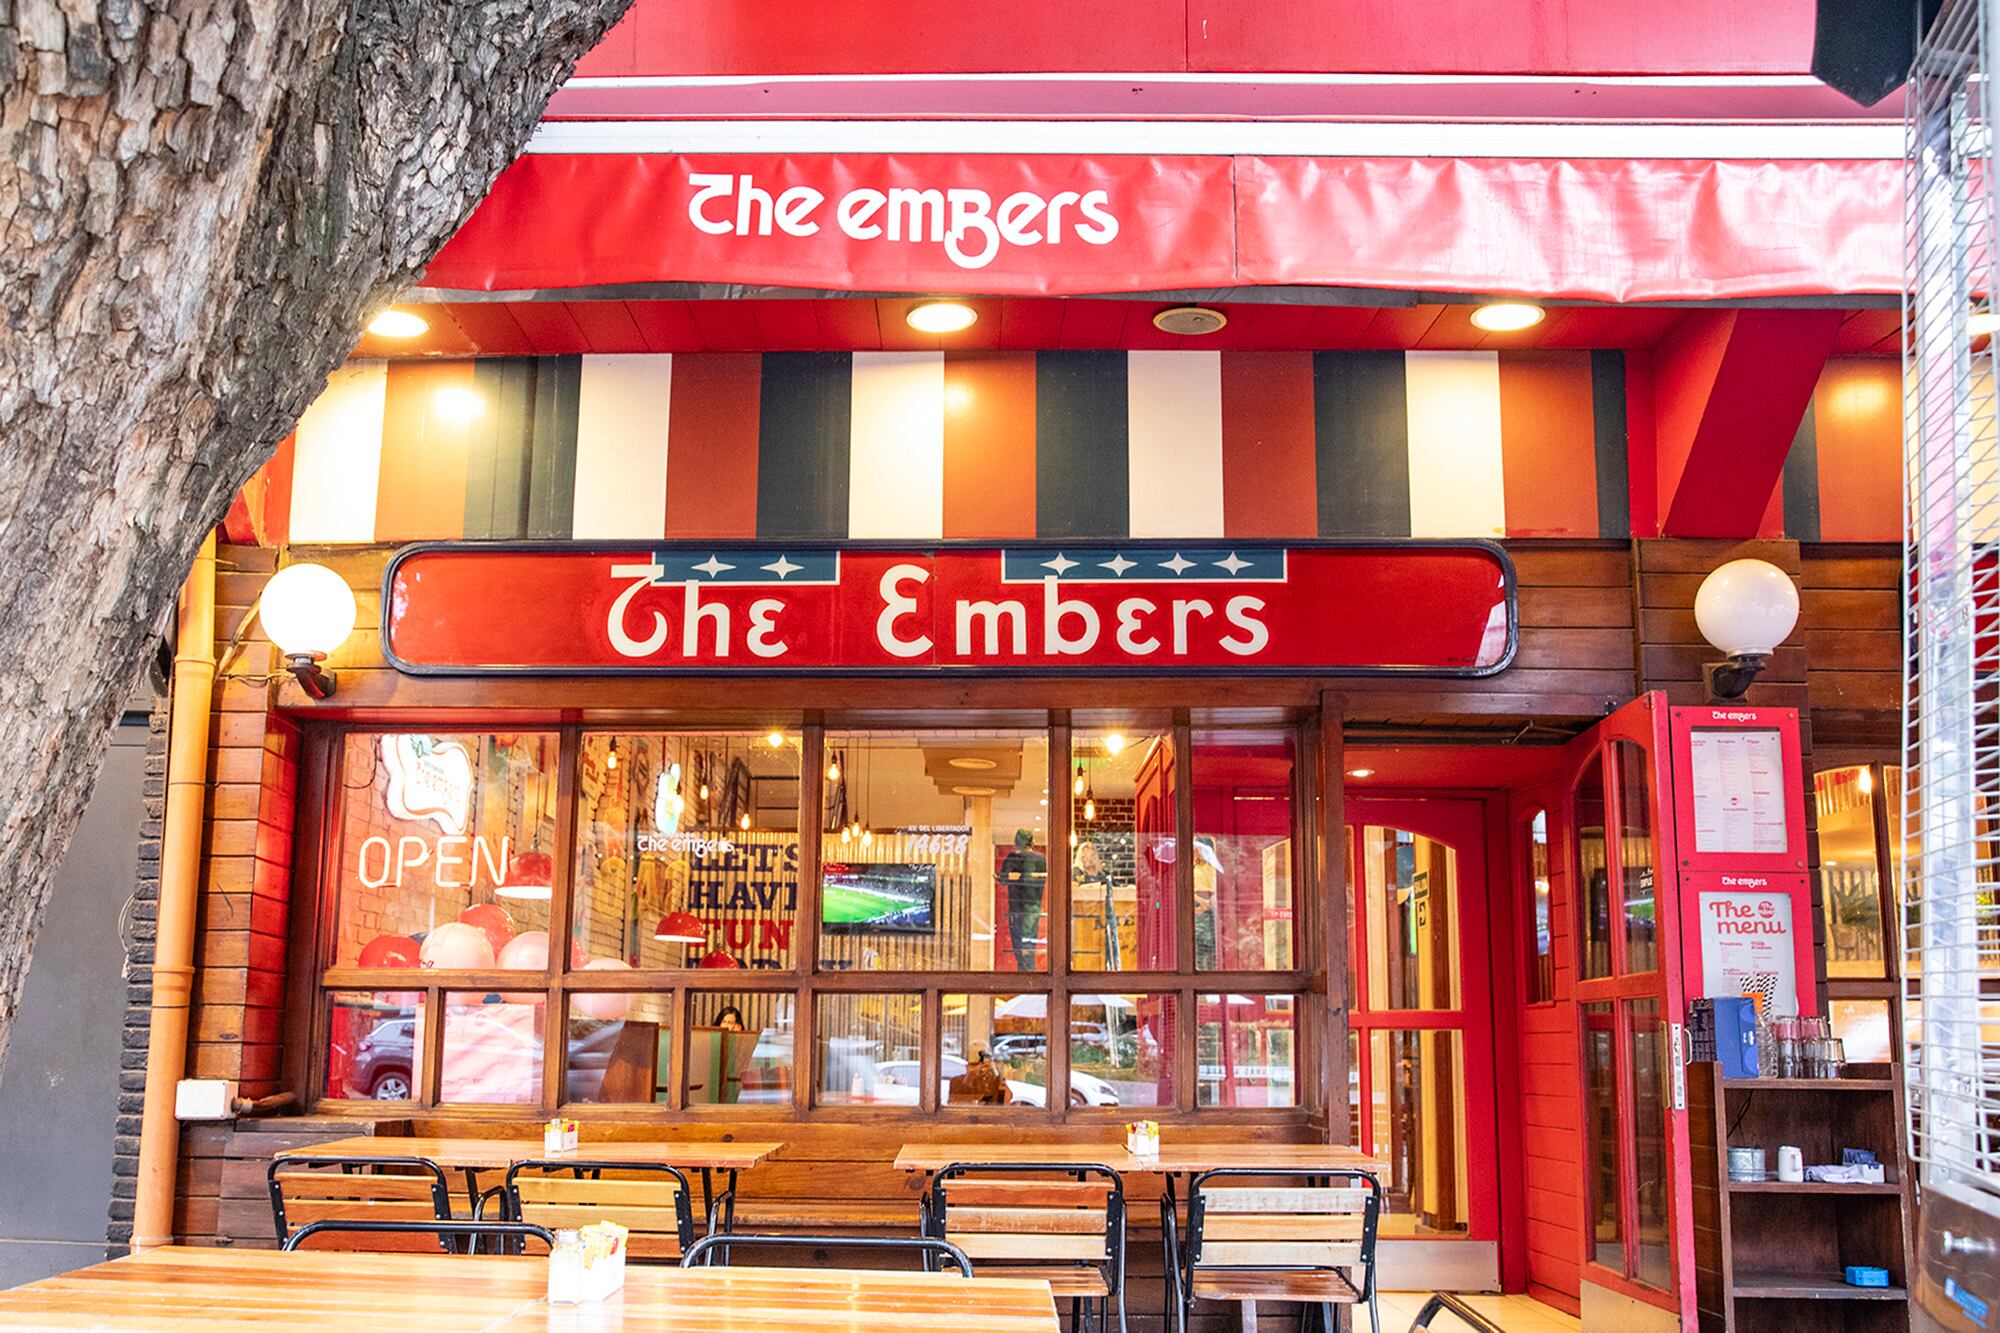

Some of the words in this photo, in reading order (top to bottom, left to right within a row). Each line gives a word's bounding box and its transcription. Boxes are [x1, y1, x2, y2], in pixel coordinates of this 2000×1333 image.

[688, 173, 825, 237] The
[607, 563, 789, 658] The
[876, 563, 1270, 658] Embers
[1711, 711, 1726, 720] The
[637, 834, 668, 851] The
[358, 835, 509, 888] OPEN
[1721, 876, 1737, 885] The
[1708, 900, 1755, 918] The
[1717, 920, 1787, 935] menu
